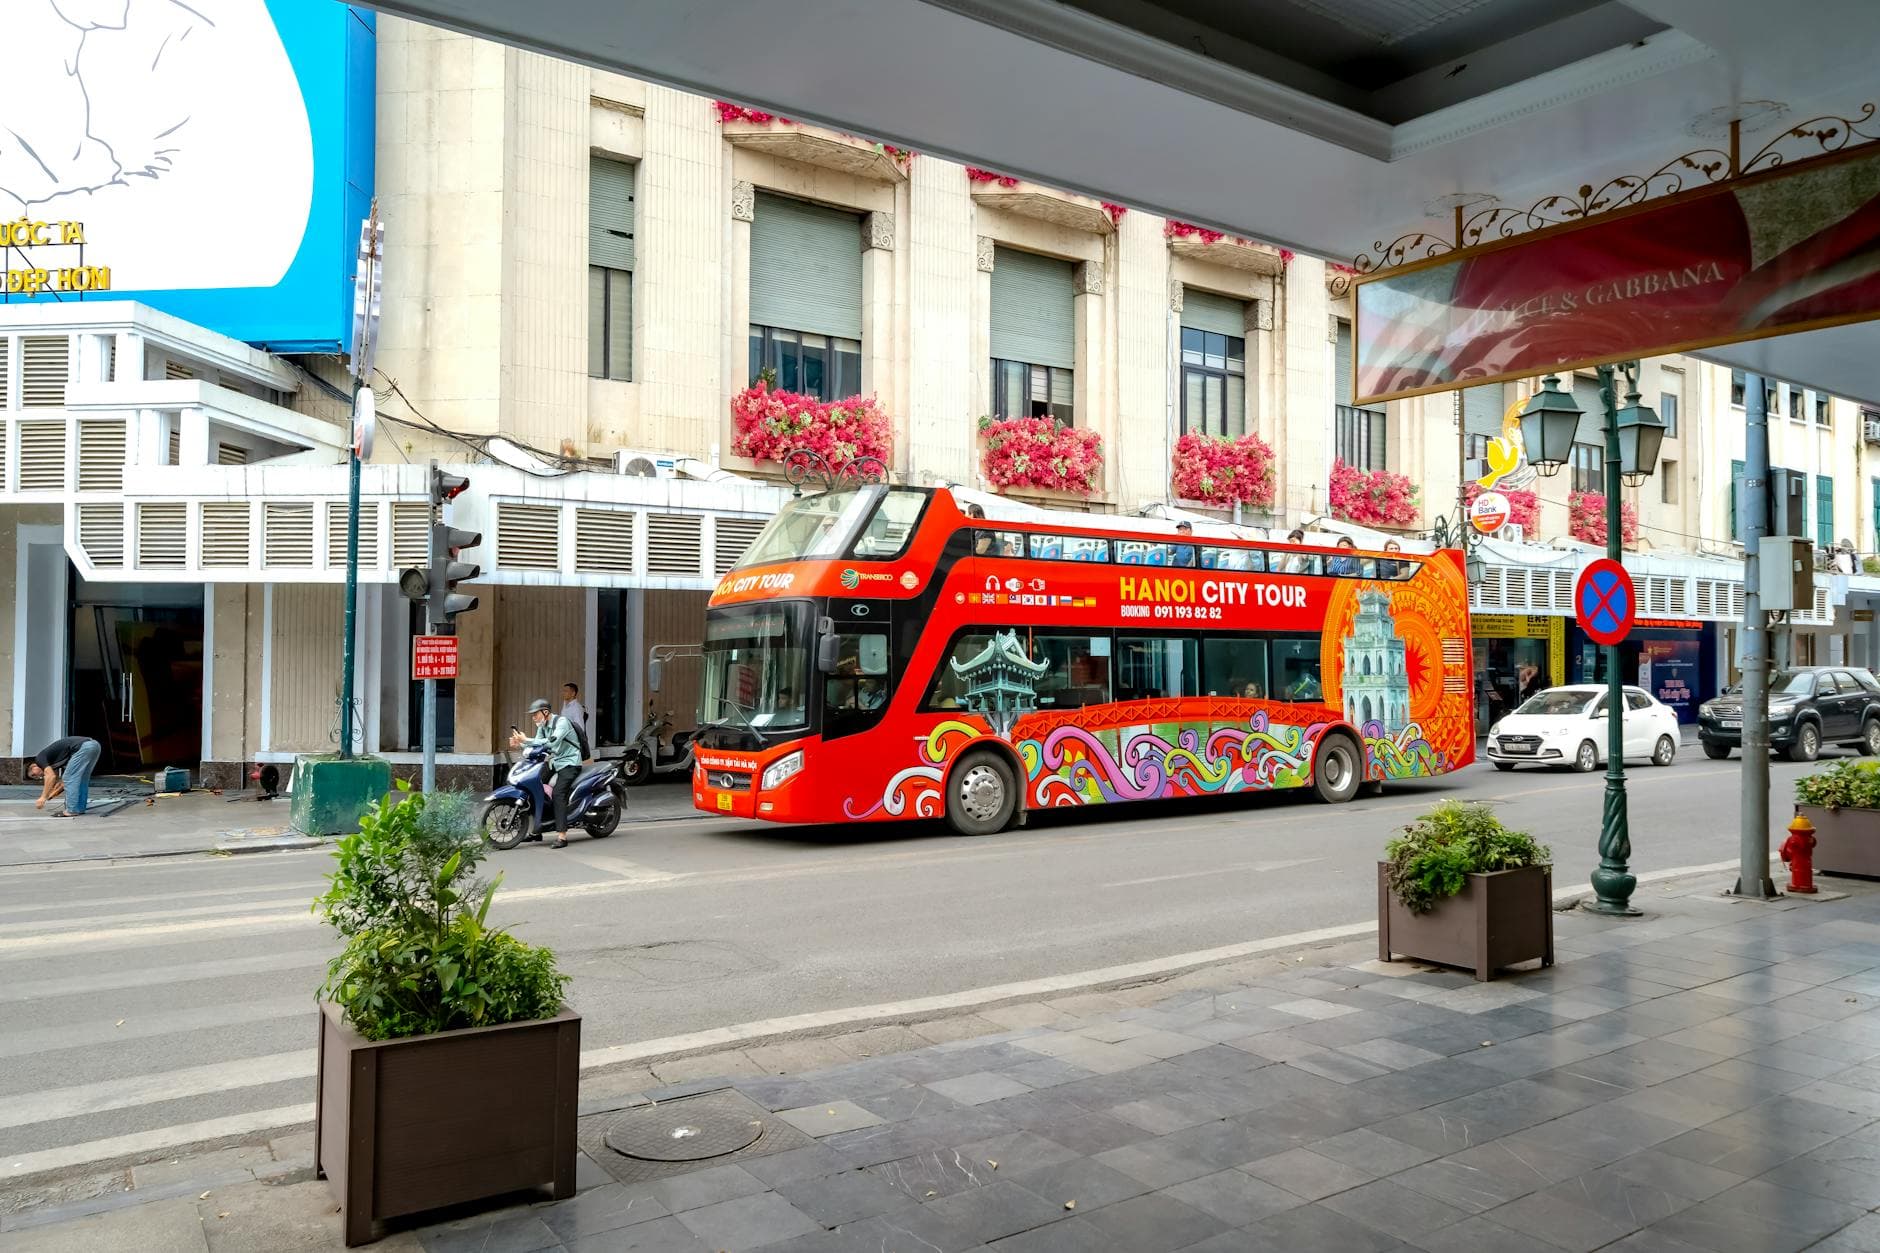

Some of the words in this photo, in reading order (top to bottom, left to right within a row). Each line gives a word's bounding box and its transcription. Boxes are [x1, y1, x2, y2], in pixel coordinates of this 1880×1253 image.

[57, 221, 87, 245] TA
[1561, 291, 1578, 310] &
[1584, 261, 1725, 306] GABBANA
[1478, 499, 1489, 507] HD
[1478, 506, 1497, 514] Bank
[733, 575, 761, 593] CITY
[758, 572, 795, 589] TOUR
[1119, 576, 1196, 603] HANOI
[1202, 580, 1248, 605] CITY
[1254, 583, 1307, 607] TOUR
[1120, 604, 1151, 618] BOOKING
[1154, 605, 1173, 618] 091
[1175, 606, 1192, 619] 193
[1194, 607, 1207, 619] 82
[1209, 607, 1222, 620] 82
